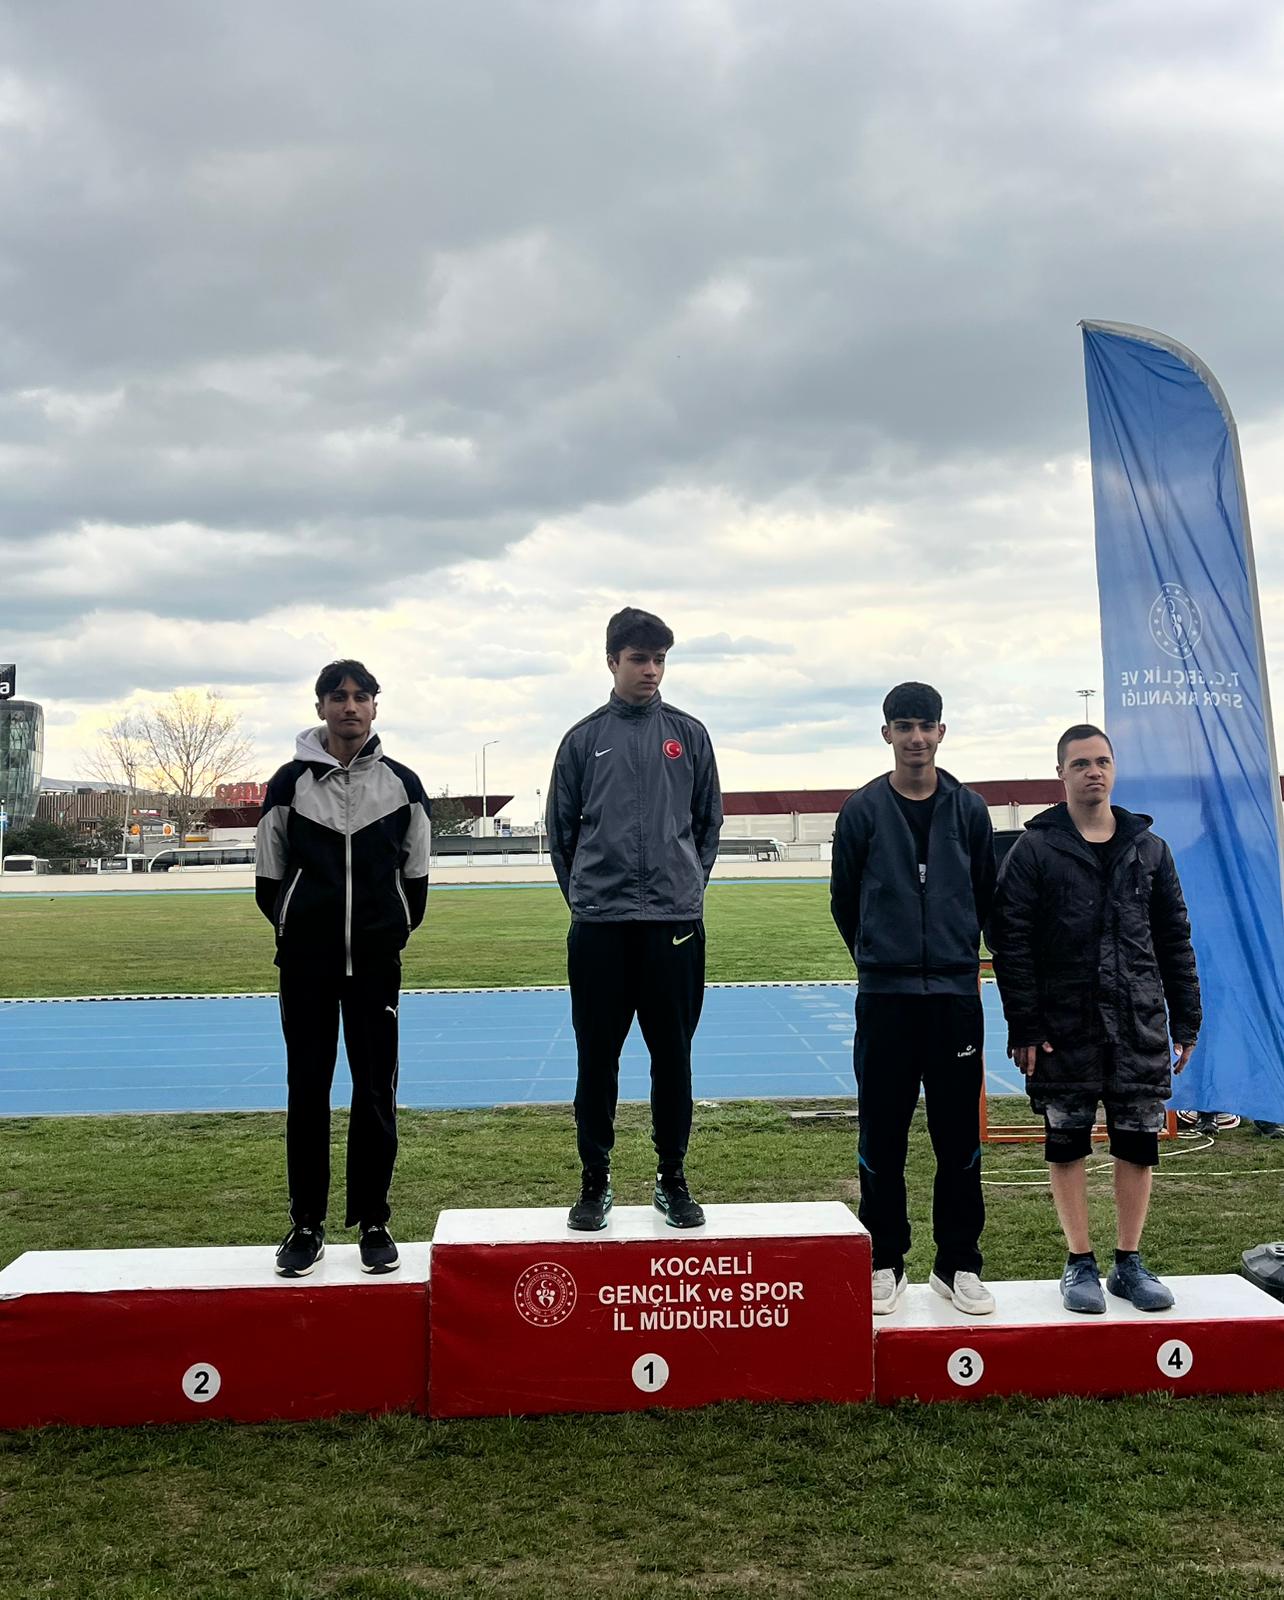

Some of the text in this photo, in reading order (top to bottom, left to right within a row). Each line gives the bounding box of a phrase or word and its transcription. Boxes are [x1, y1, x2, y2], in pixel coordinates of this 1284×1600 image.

[650, 1251, 753, 1277] KOCAELİ
[598, 1279, 805, 1308] GENÇLİK ve SPOR
[613, 1304, 790, 1331] İL MÜDÜRLÜĞÜ
[958, 1355, 973, 1378] 3
[1167, 1347, 1183, 1370] 4
[193, 1370, 210, 1394] 2
[643, 1361, 654, 1384] 1
